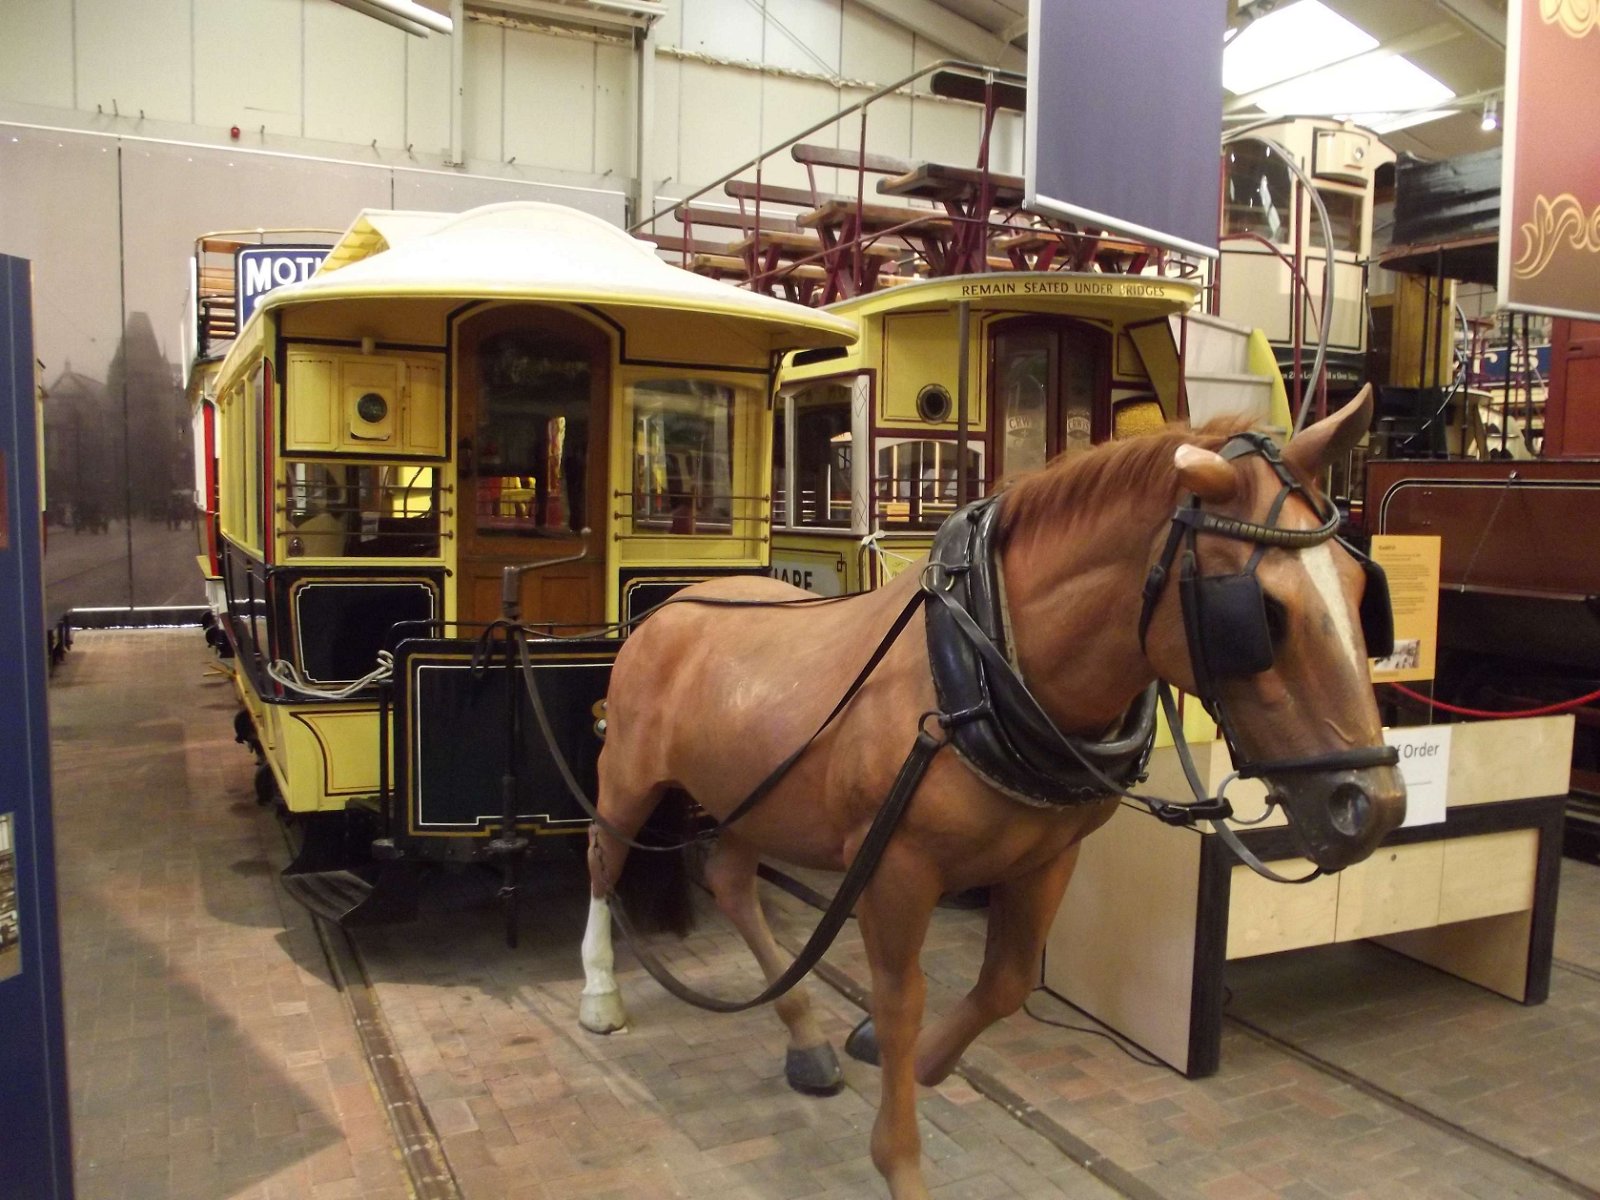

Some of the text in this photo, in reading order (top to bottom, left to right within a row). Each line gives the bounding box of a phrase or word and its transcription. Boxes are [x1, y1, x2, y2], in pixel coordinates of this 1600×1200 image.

[962, 283, 1016, 296] REMAIN
[1024, 282, 1069, 294] SEATED
[1075, 282, 1113, 294] UNDER
[1403, 742, 1440, 759] Order
